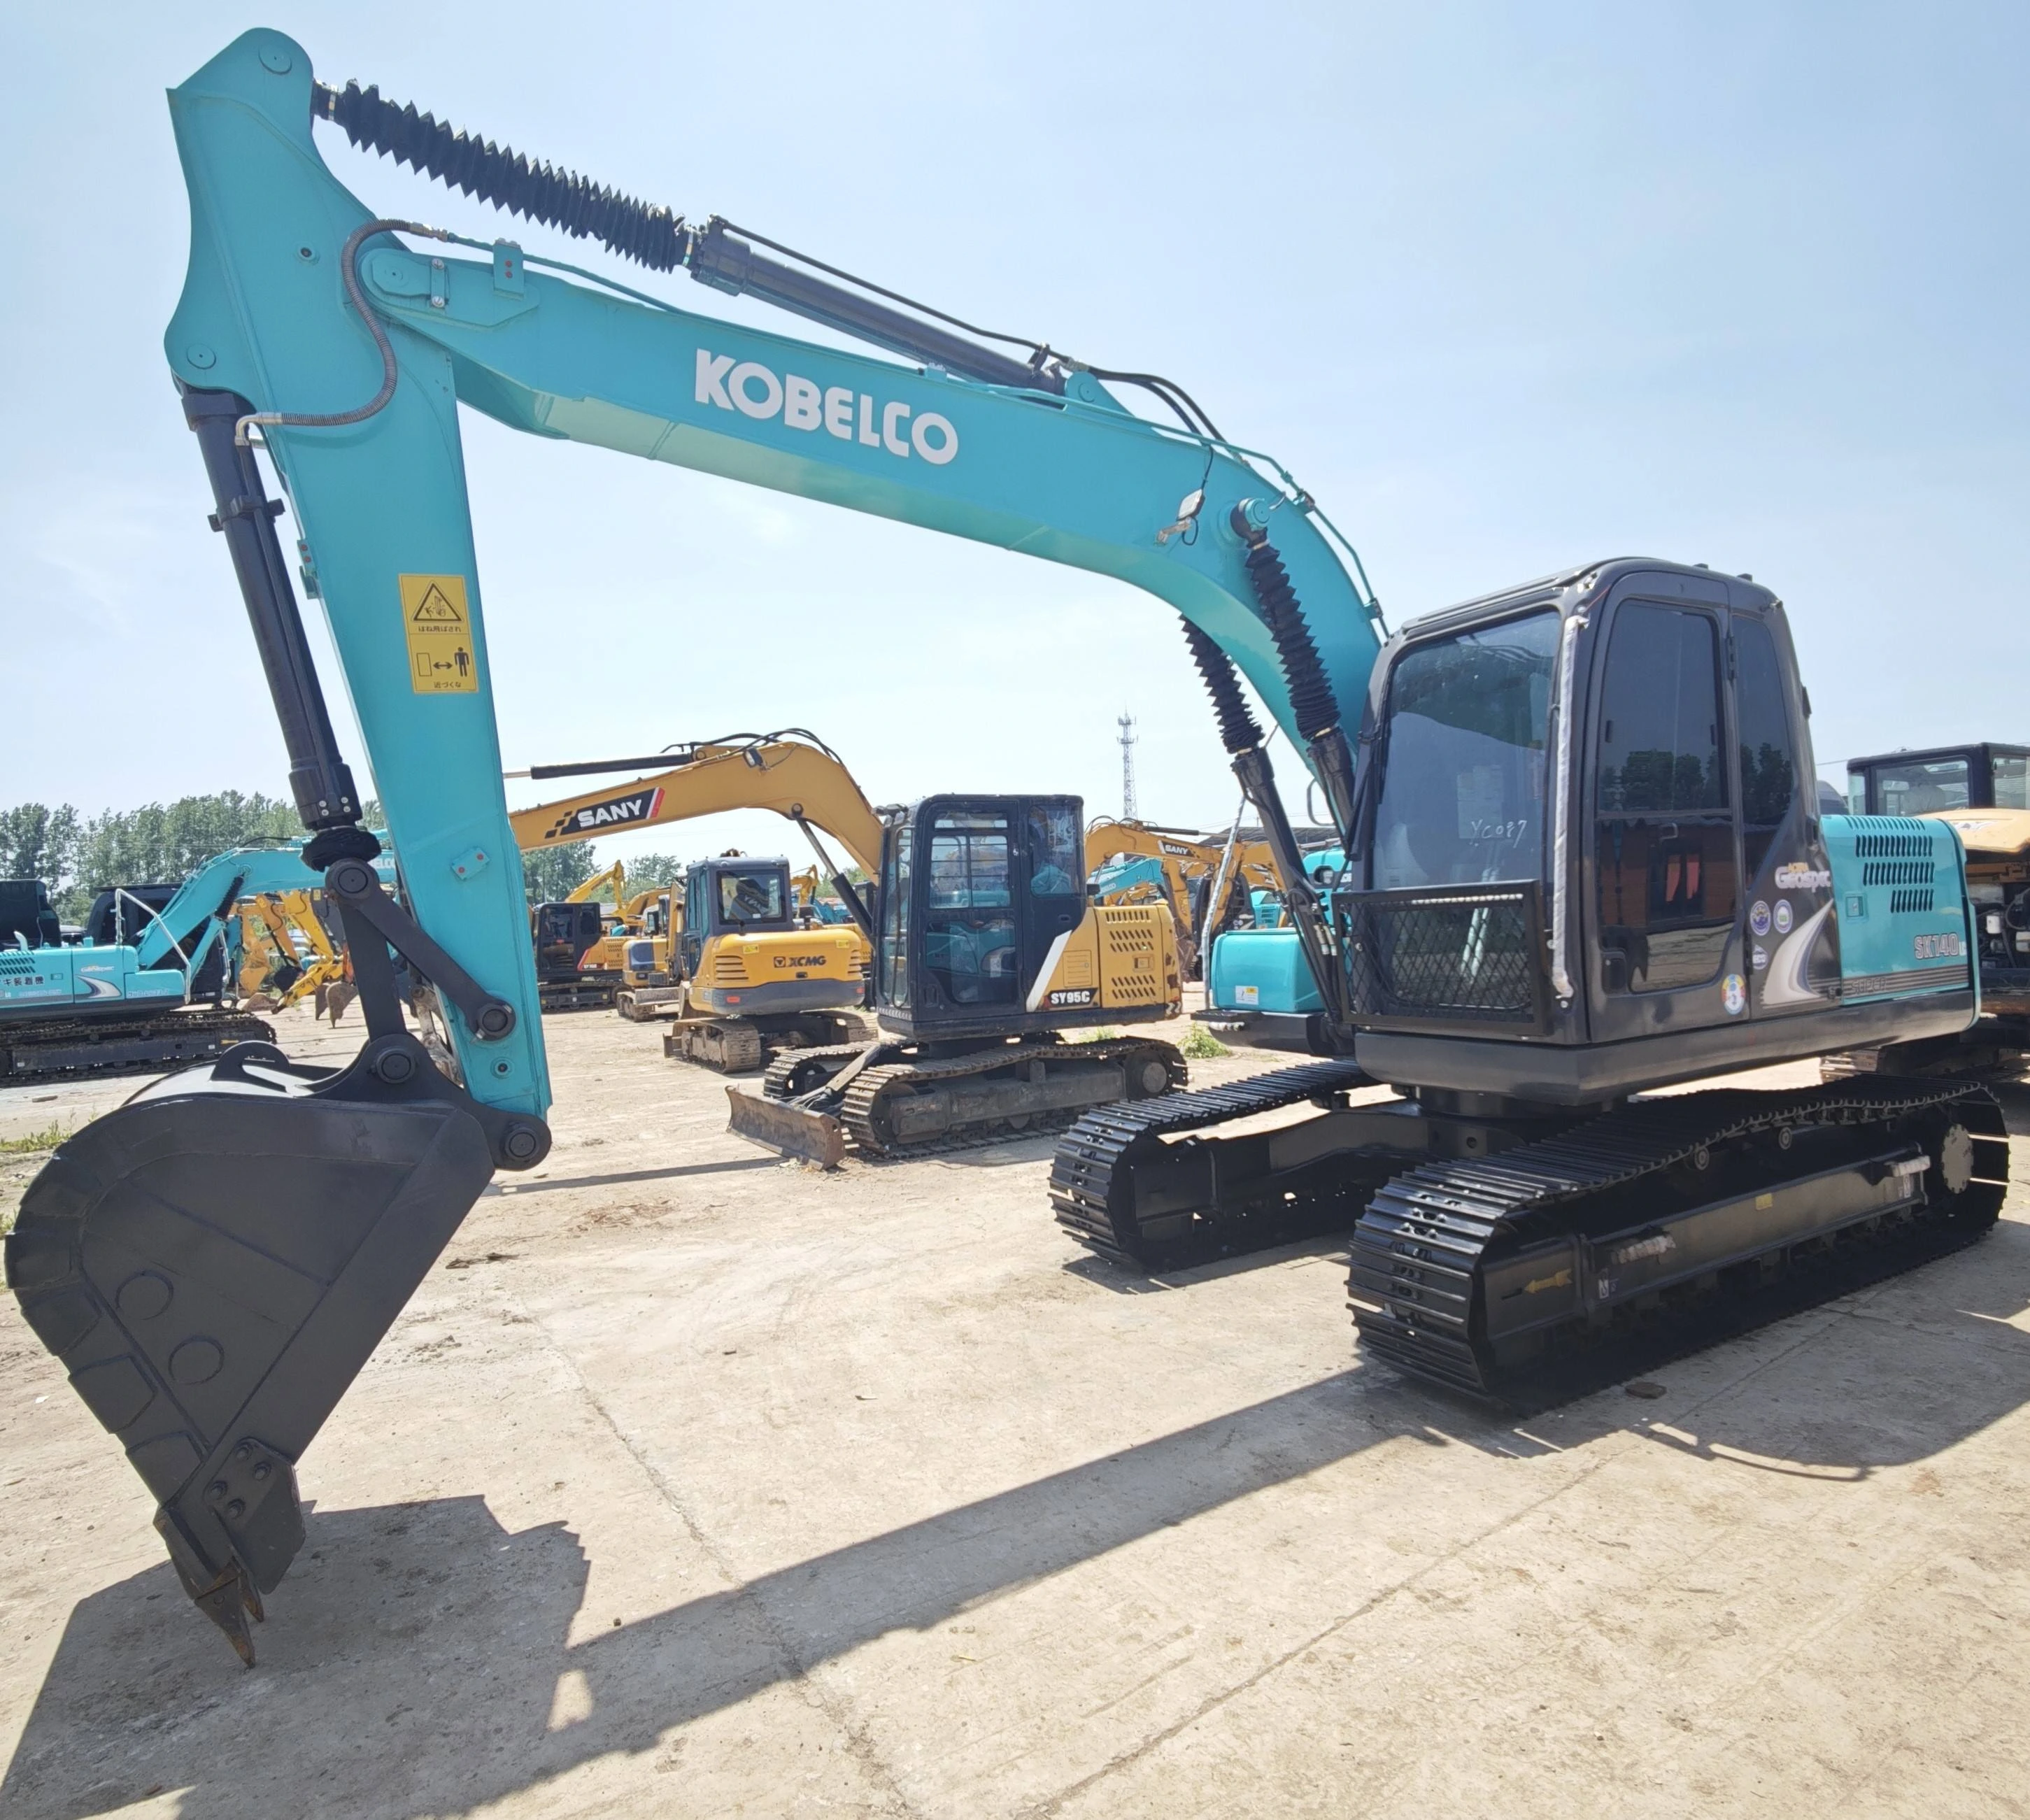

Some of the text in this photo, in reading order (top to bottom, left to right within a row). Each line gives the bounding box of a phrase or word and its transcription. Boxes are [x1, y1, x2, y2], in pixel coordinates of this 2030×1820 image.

[695, 348, 958, 465] KOBELCO
[578, 799, 642, 827] SANY
[1165, 844, 1188, 855] SANY
[788, 955, 827, 967] XCMG
[1051, 990, 1091, 1004] SY95C
